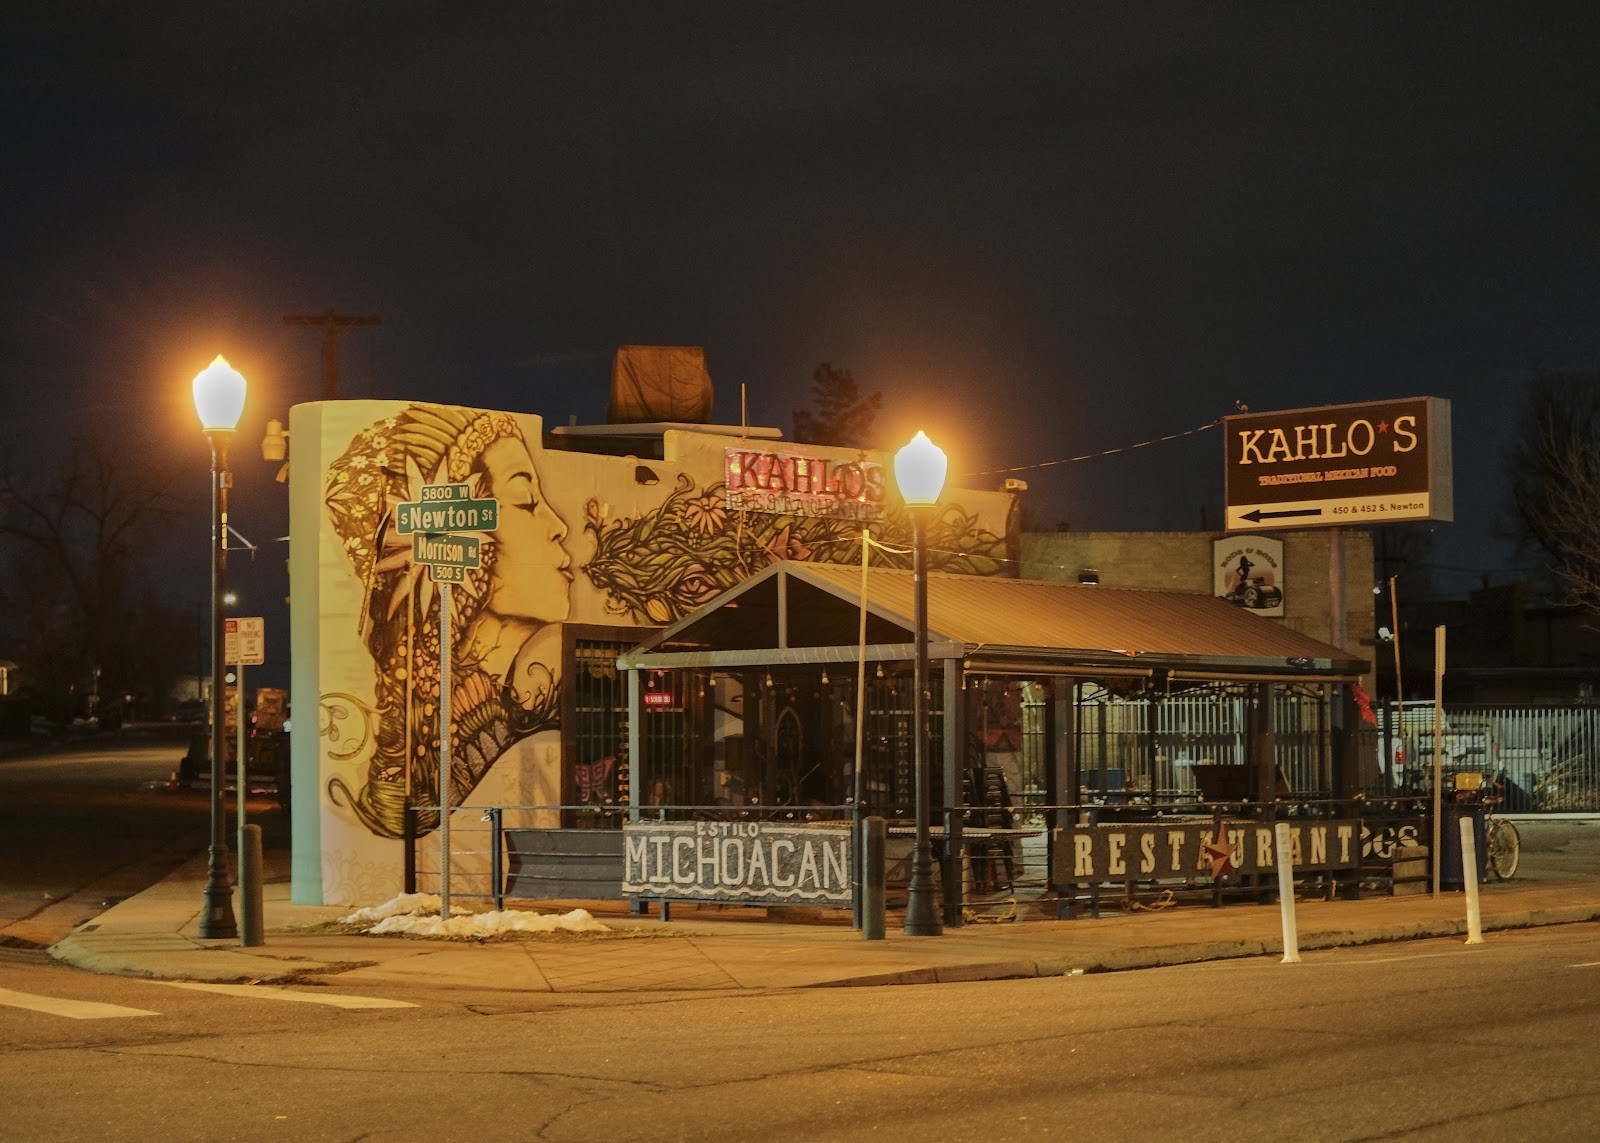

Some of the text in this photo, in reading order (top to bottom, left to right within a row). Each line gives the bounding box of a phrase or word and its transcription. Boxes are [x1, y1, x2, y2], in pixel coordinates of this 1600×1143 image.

[1324, 468, 1369, 481] MEXICAN
[1370, 466, 1397, 477] FOOD
[423, 486, 469, 500] 3800 W
[1332, 506, 1349, 515] 450
[1351, 506, 1358, 514] &
[1360, 504, 1377, 513] 452
[1390, 502, 1424, 511] Newton
[401, 505, 493, 530] S Newton St
[418, 536, 464, 562] Morrison
[436, 567, 461, 580] 500 S
[697, 821, 759, 837] ESTILO
[625, 836, 848, 889] MICHOACAN
